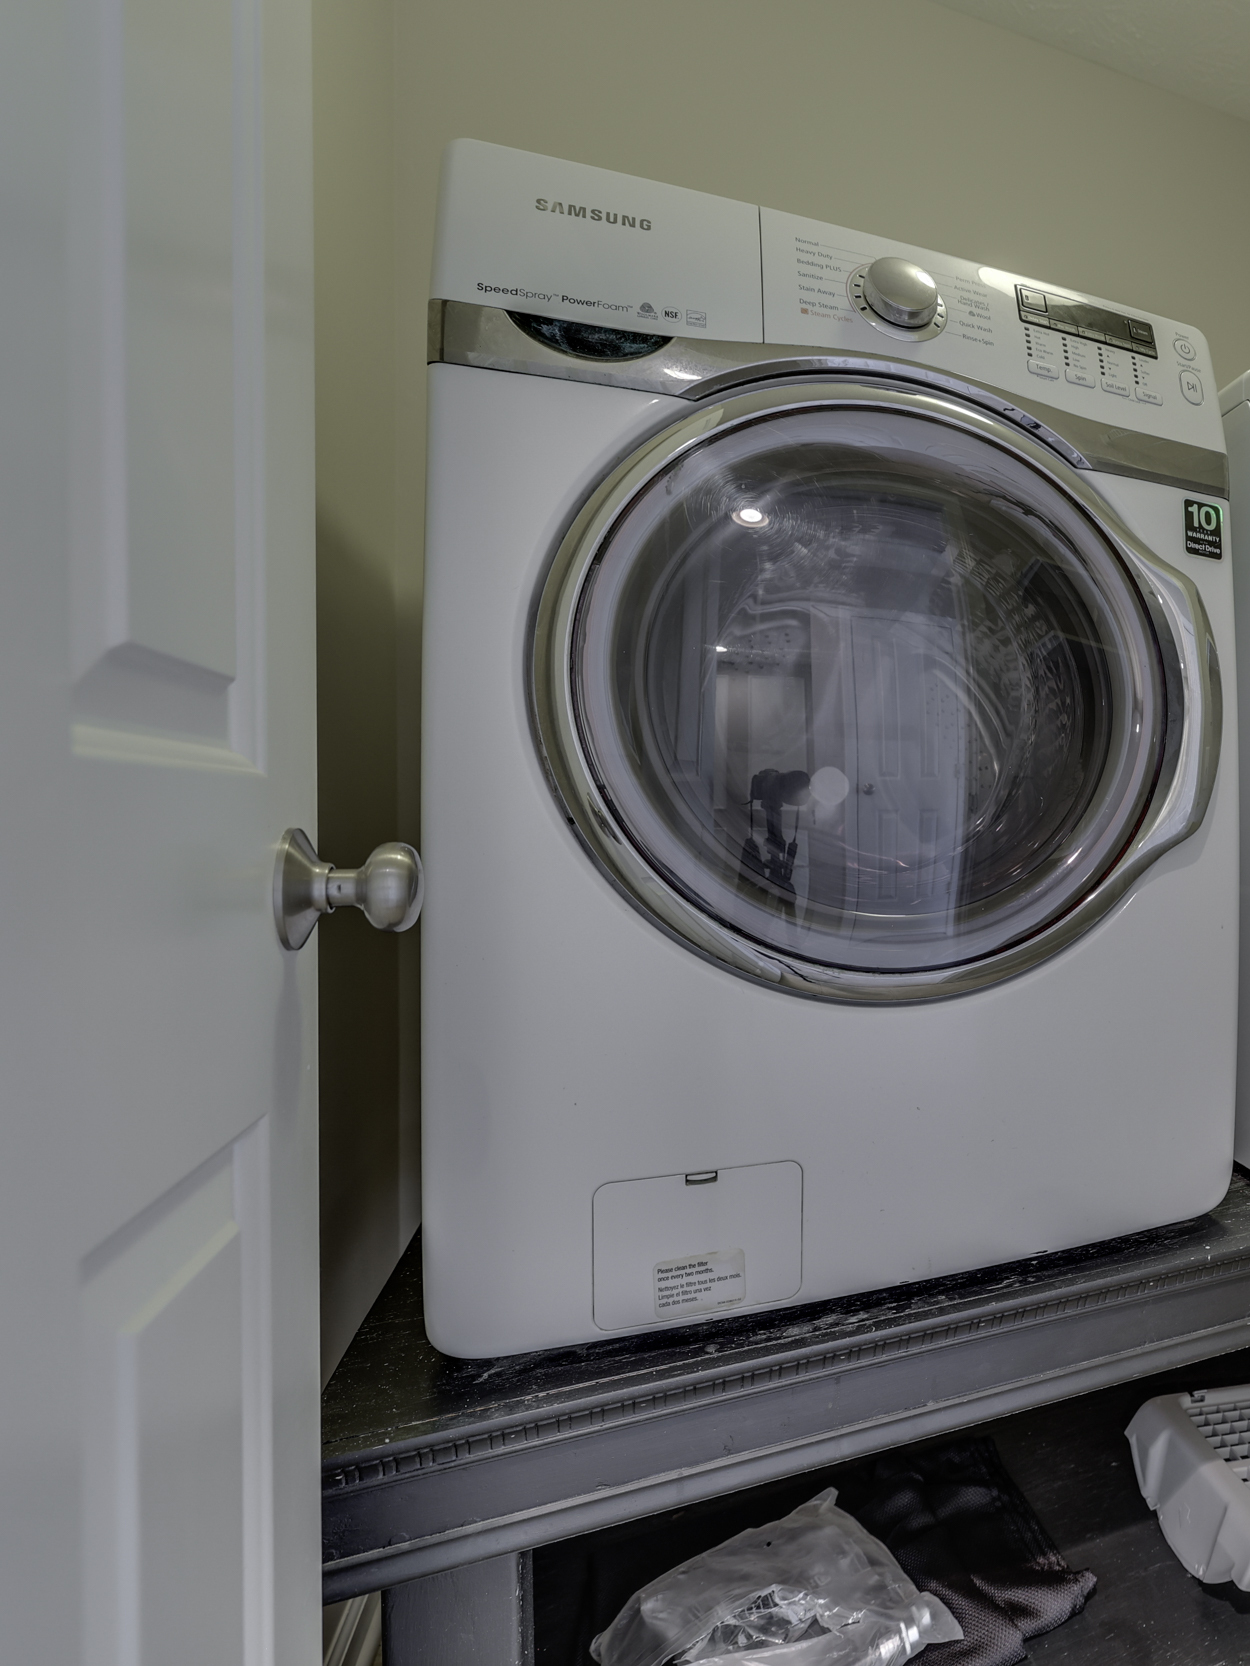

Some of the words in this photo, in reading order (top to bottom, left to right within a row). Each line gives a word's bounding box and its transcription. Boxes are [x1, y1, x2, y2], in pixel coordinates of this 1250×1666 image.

[535, 198, 652, 231] SAMSUNG
[795, 237, 819, 246] Normal
[796, 247, 816, 256] Heavy
[818, 251, 833, 260] Duty
[797, 258, 823, 269] Bedding
[825, 264, 842, 272] PLUS
[797, 271, 823, 280] Sanitize
[798, 284, 815, 293] Stain
[817, 288, 835, 298] Away
[954, 285, 971, 293] Active
[799, 298, 816, 307] Deep
[818, 302, 839, 310] Steam
[974, 304, 990, 312] Wash
[810, 310, 831, 318] Steam
[833, 314, 853, 323] Cycles
[976, 312, 991, 320] Wool
[959, 320, 975, 329] Quick
[976, 325, 992, 333] Wash
[1175, 331, 1189, 340] Power
[1036, 363, 1053, 373] Temp.
[1074, 373, 1087, 382] Spin
[1105, 381, 1114, 389] Soil
[1114, 384, 1127, 392] Level
[1142, 391, 1158, 401] Signal
[1187, 503, 1217, 531] 10
[1187, 530, 1220, 543] WARRANTY
[1187, 541, 1205, 550] Direct
[1205, 545, 1221, 554] Drive
[674, 1264, 687, 1272] clean
[657, 1275, 669, 1283] once
[670, 1272, 684, 1280] every
[695, 1267, 714, 1275] months.
[658, 1284, 679, 1293] Nettoyez
[717, 1274, 728, 1282] deux
[729, 1272, 742, 1280] mois.
[658, 1292, 674, 1301] Limpie
[658, 1301, 671, 1309] cada
[681, 1296, 699, 1304] meses.
